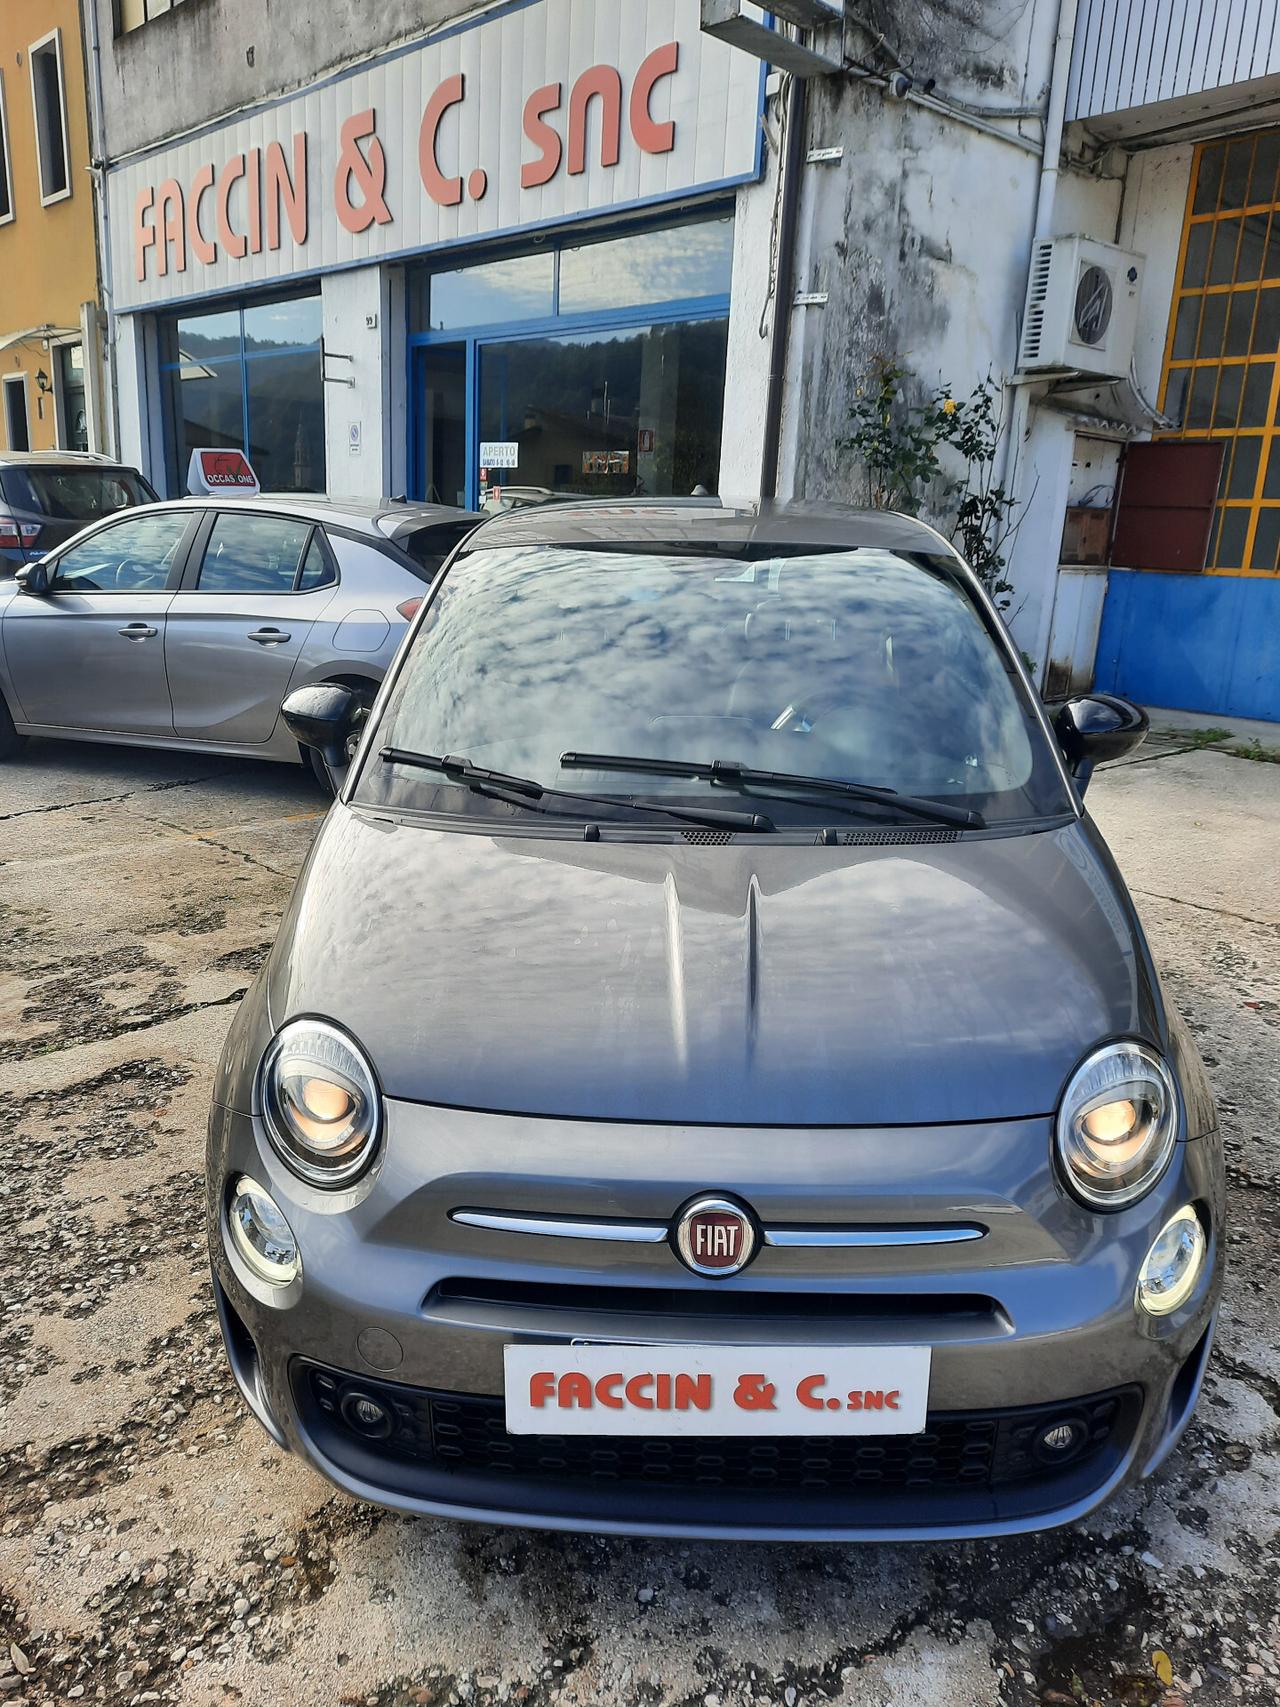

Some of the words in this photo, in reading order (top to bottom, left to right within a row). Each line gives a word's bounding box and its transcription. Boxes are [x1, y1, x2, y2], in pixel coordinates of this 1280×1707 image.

[135, 131, 309, 282] FACCIN
[334, 107, 394, 234] &
[419, 73, 487, 207] C.
[521, 40, 679, 189] snc
[482, 446, 516, 457] APERTO
[207, 474, 254, 484] OCCASONE
[696, 1224, 739, 1256] FIAT
[529, 1372, 711, 1411] FACCIN
[733, 1374, 778, 1411] &
